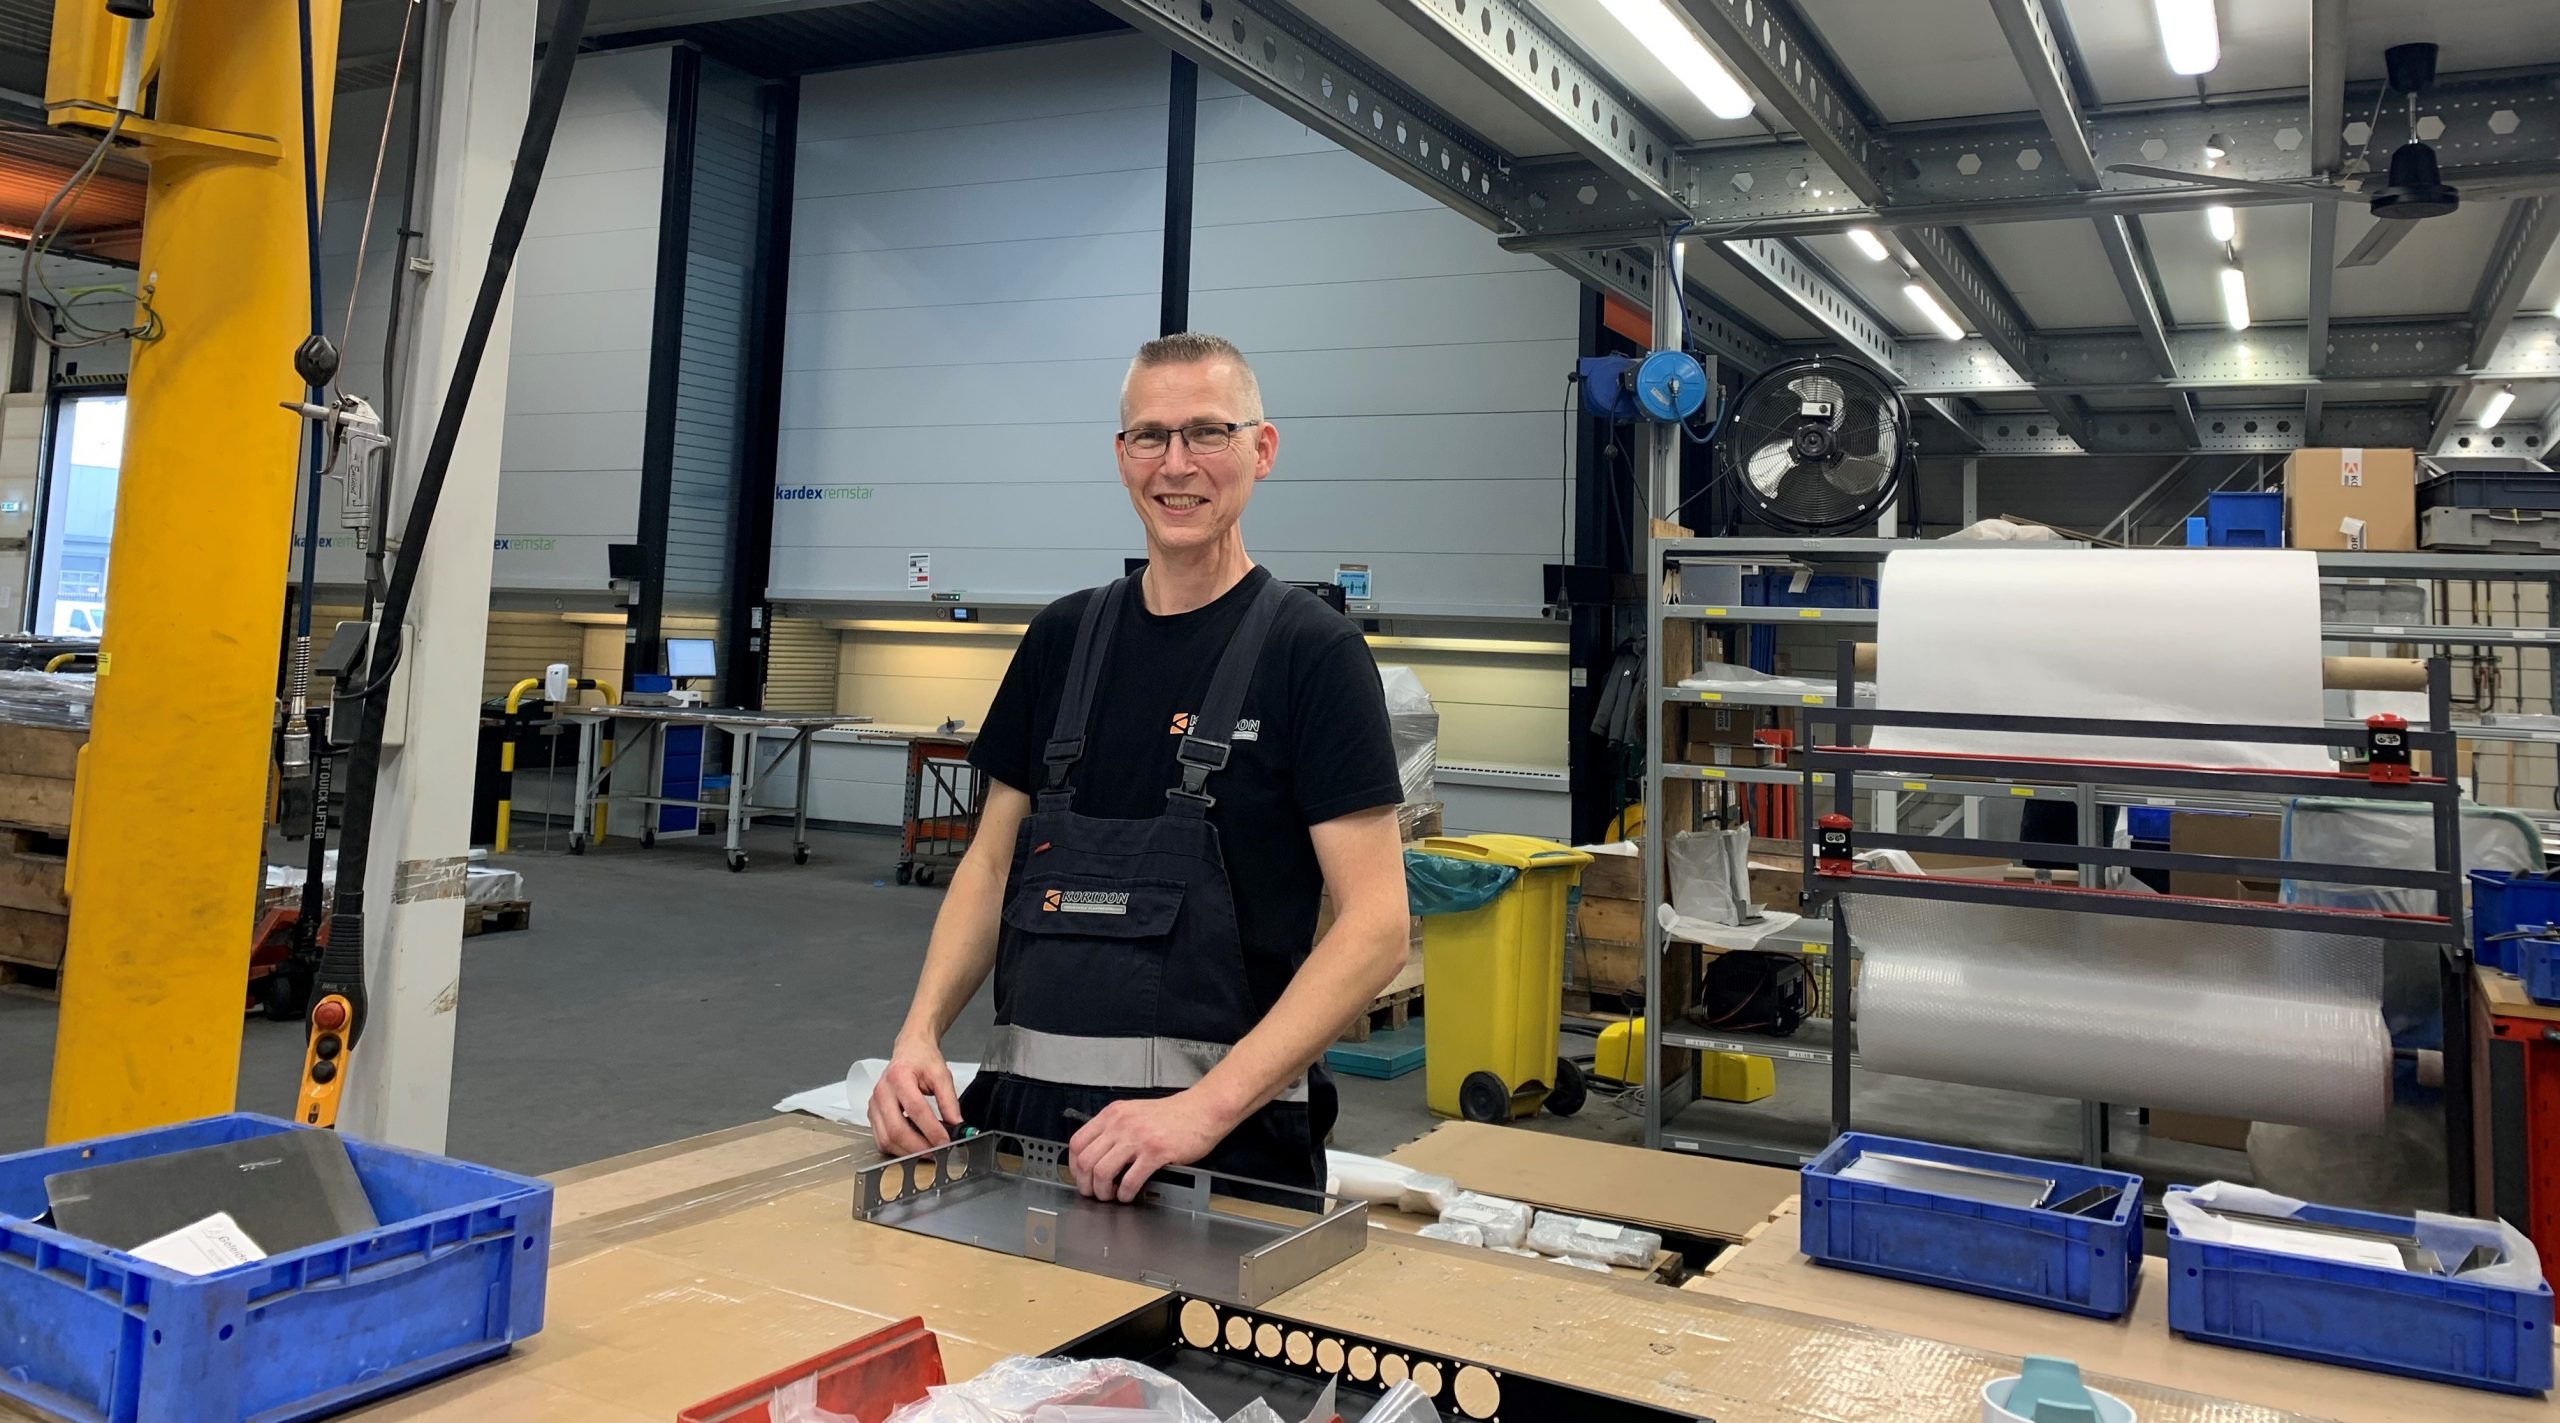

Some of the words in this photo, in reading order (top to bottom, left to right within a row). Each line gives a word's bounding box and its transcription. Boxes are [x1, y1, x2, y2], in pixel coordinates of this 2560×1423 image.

[320, 757, 332, 770] BT
[318, 772, 331, 803] QUICK
[314, 805, 328, 839] LIFTER
[1061, 891, 1130, 905] KORIDON
